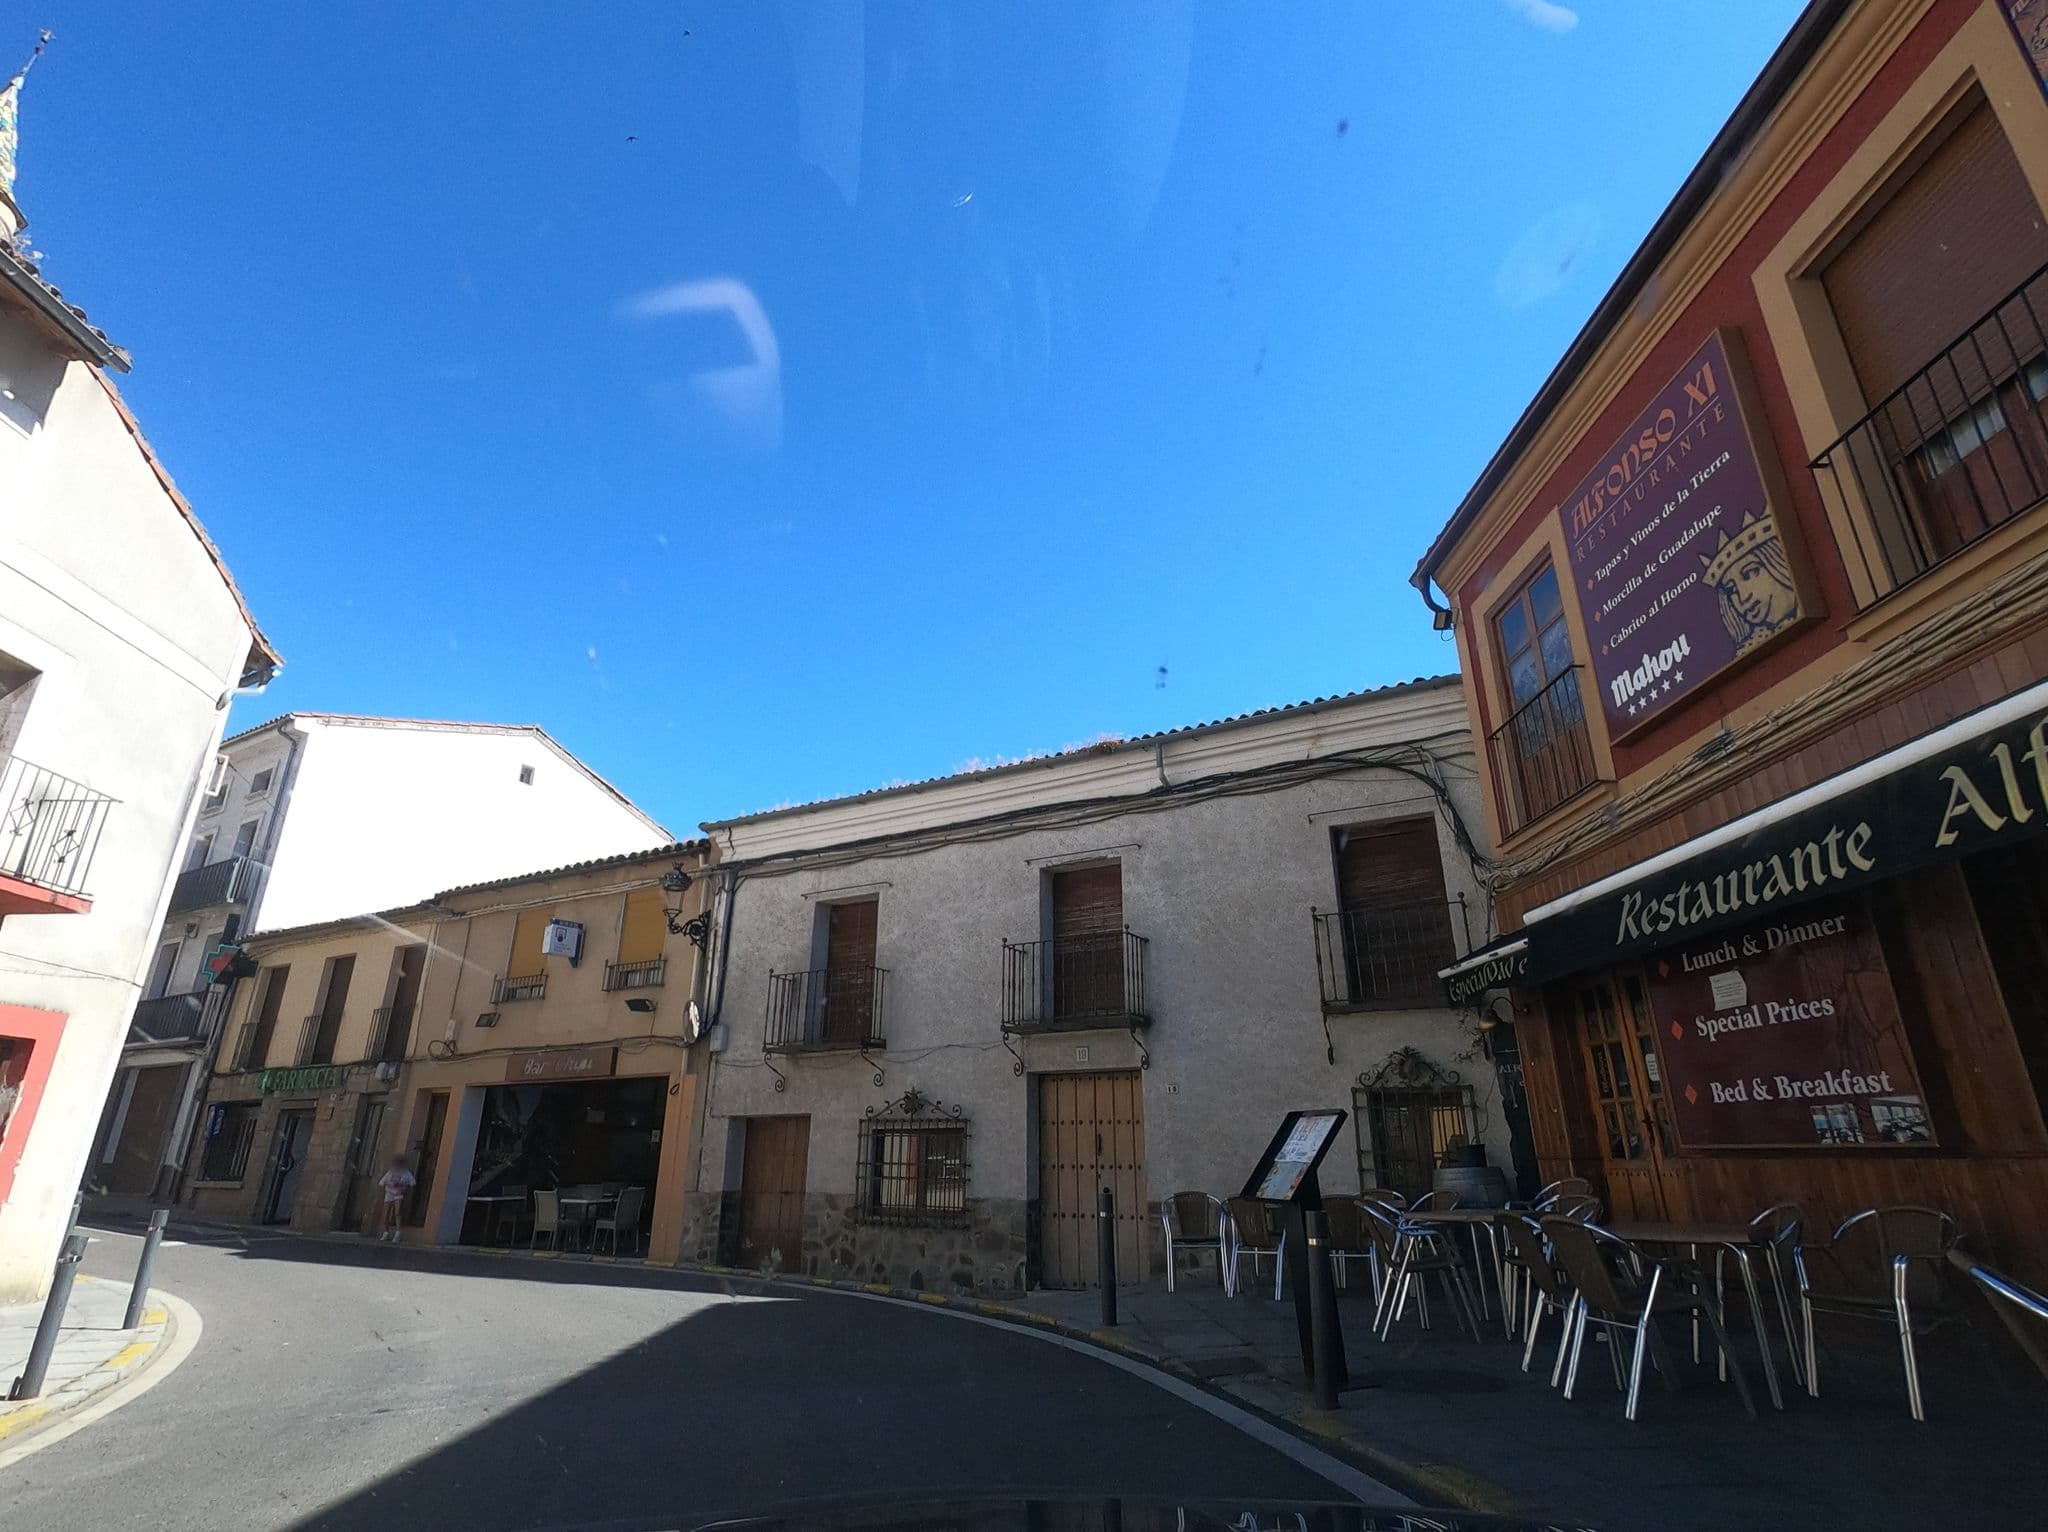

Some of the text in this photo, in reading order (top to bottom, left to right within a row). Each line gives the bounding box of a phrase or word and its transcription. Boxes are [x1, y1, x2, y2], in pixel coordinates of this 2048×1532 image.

[1571, 361, 1717, 539] ALFONSO XI
[1576, 403, 1726, 562] RESTAURANTE
[1594, 450, 1731, 582] Tapas y Vinos de la Tierra
[1602, 504, 1723, 616] Morcilla de Guadalupe
[1610, 571, 1698, 648] Cabrito al Horno
[1610, 632, 1691, 708] Mahou
[1616, 820, 1876, 946] Restaurante
[1681, 914, 1846, 973] Lunch & Dinner
[1695, 997, 1835, 1042] Special Prices
[274, 1067, 338, 1090] FARMACIA
[1709, 1068, 1895, 1104] Bed & Breakfast
